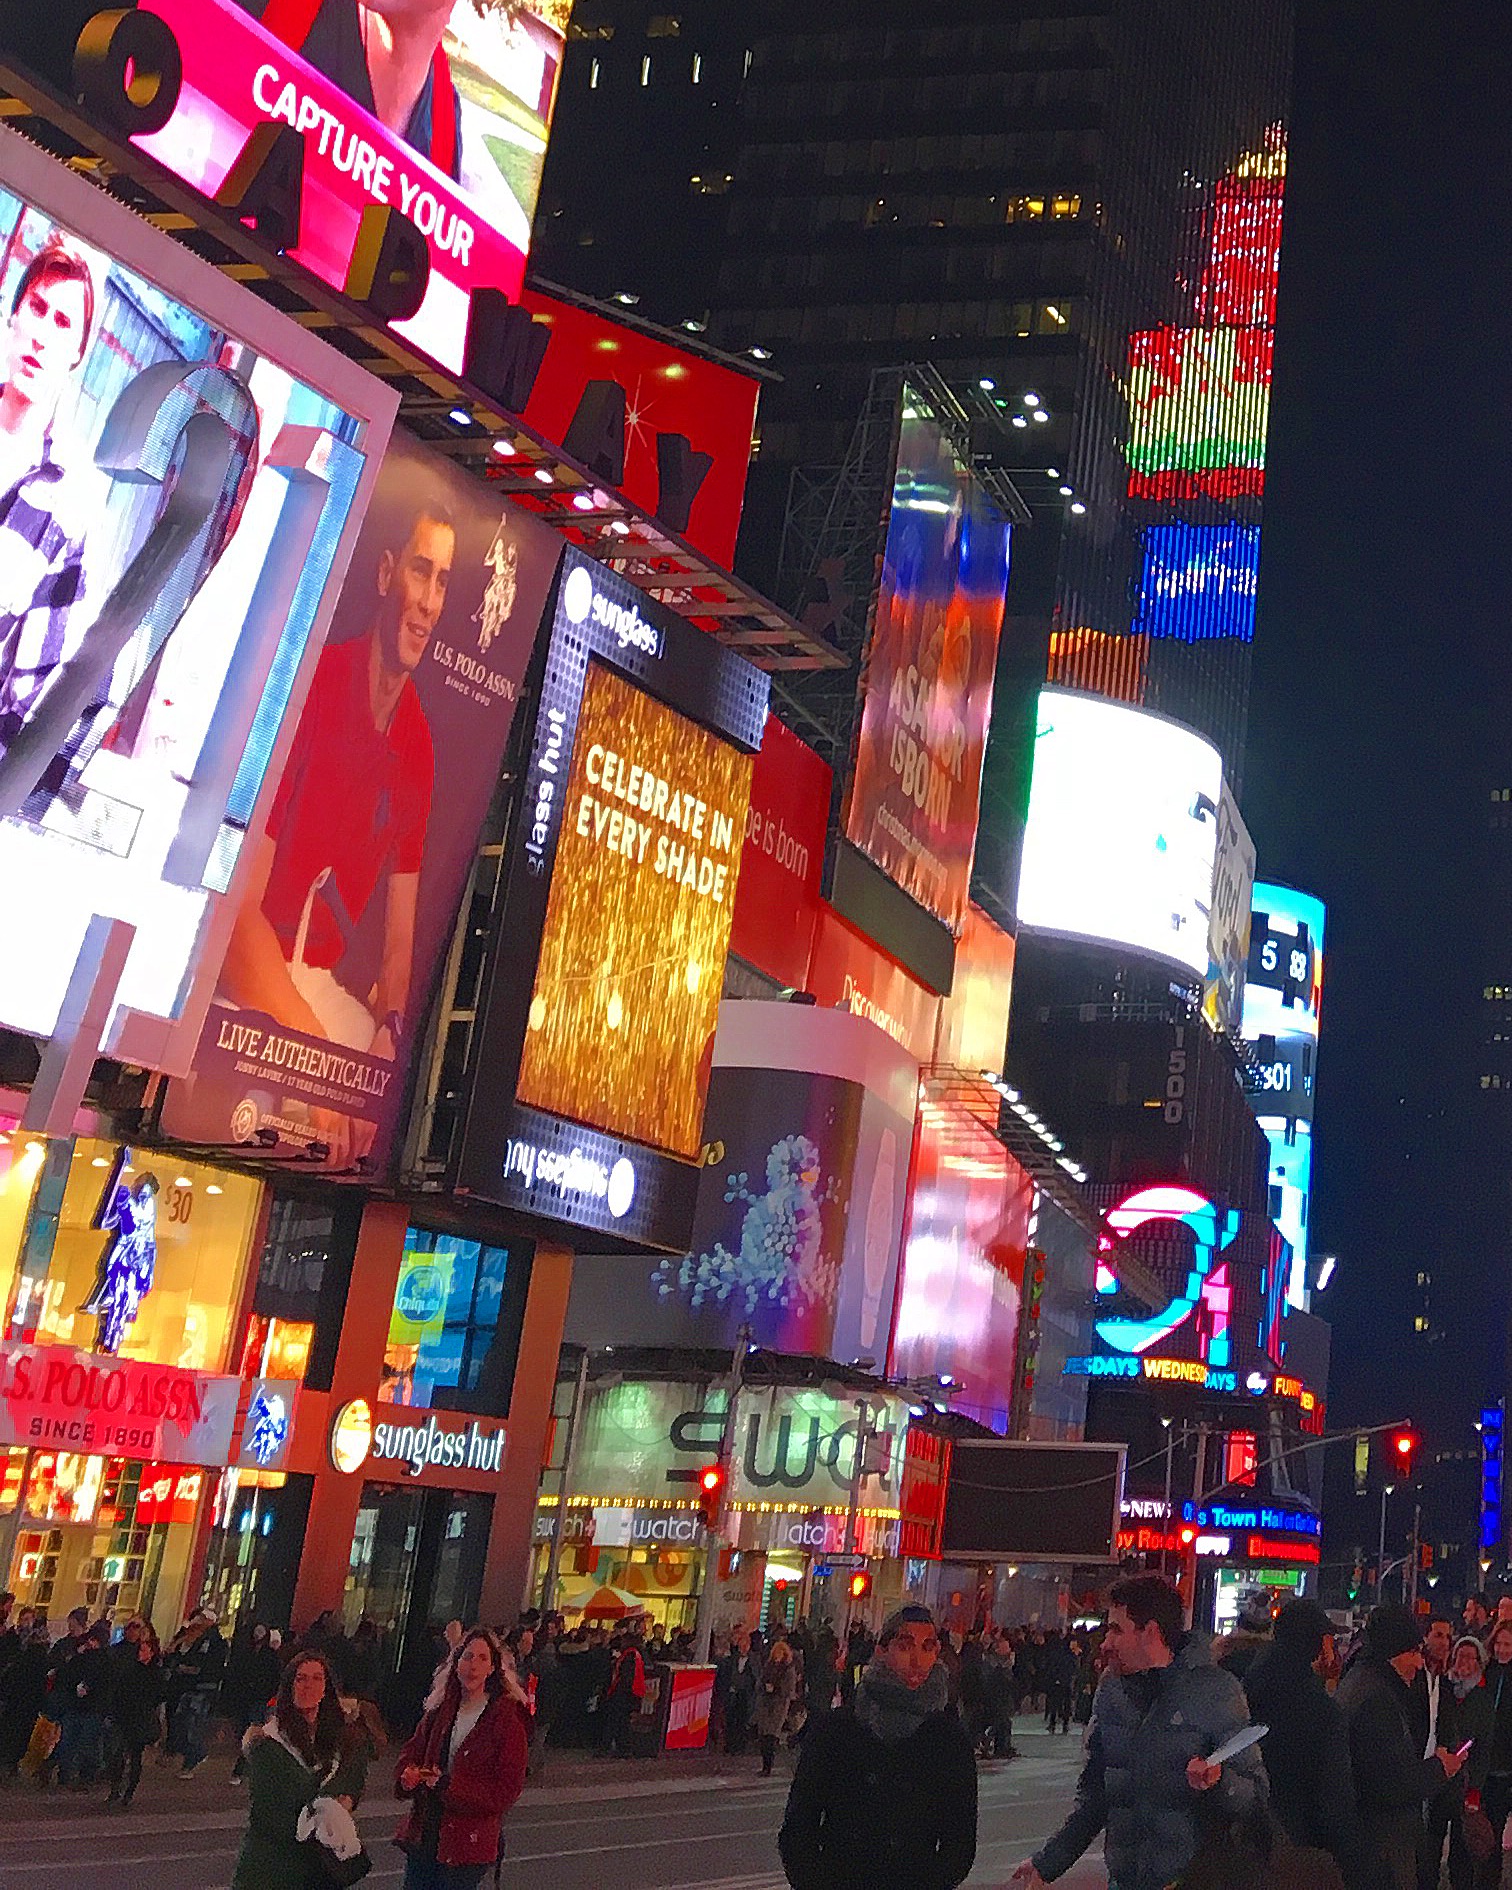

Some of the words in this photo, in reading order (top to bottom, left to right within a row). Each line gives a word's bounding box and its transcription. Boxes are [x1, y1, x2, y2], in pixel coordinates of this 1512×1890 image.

[252, 63, 394, 204] CAPTURE
[399, 172, 475, 267] YOUR
[591, 592, 659, 656] sunglass
[433, 640, 453, 670] U.S.
[453, 652, 487, 686] POLO
[484, 671, 516, 702] ASSN.
[538, 707, 566, 775] hut
[585, 744, 707, 841] CELEBRATE
[709, 809, 734, 854] IN
[576, 794, 652, 865] EVERY
[653, 835, 728, 904] SHADE
[763, 808, 776, 856] is
[777, 817, 810, 881] born
[216, 1020, 262, 1057] LIVE
[260, 1034, 392, 1098] AUTHENTICALLY
[1162, 1025, 1188, 1124] 1500
[165, 1184, 194, 1225] $30
[40, 1361, 127, 1412] POLO
[128, 1373, 209, 1425] ASSN.
[29, 1417, 95, 1442] SINCE
[104, 1425, 155, 1449] 1890
[373, 1415, 466, 1477] sunglass
[467, 1421, 506, 1473] hut
[1211, 1507, 1257, 1528] Town
